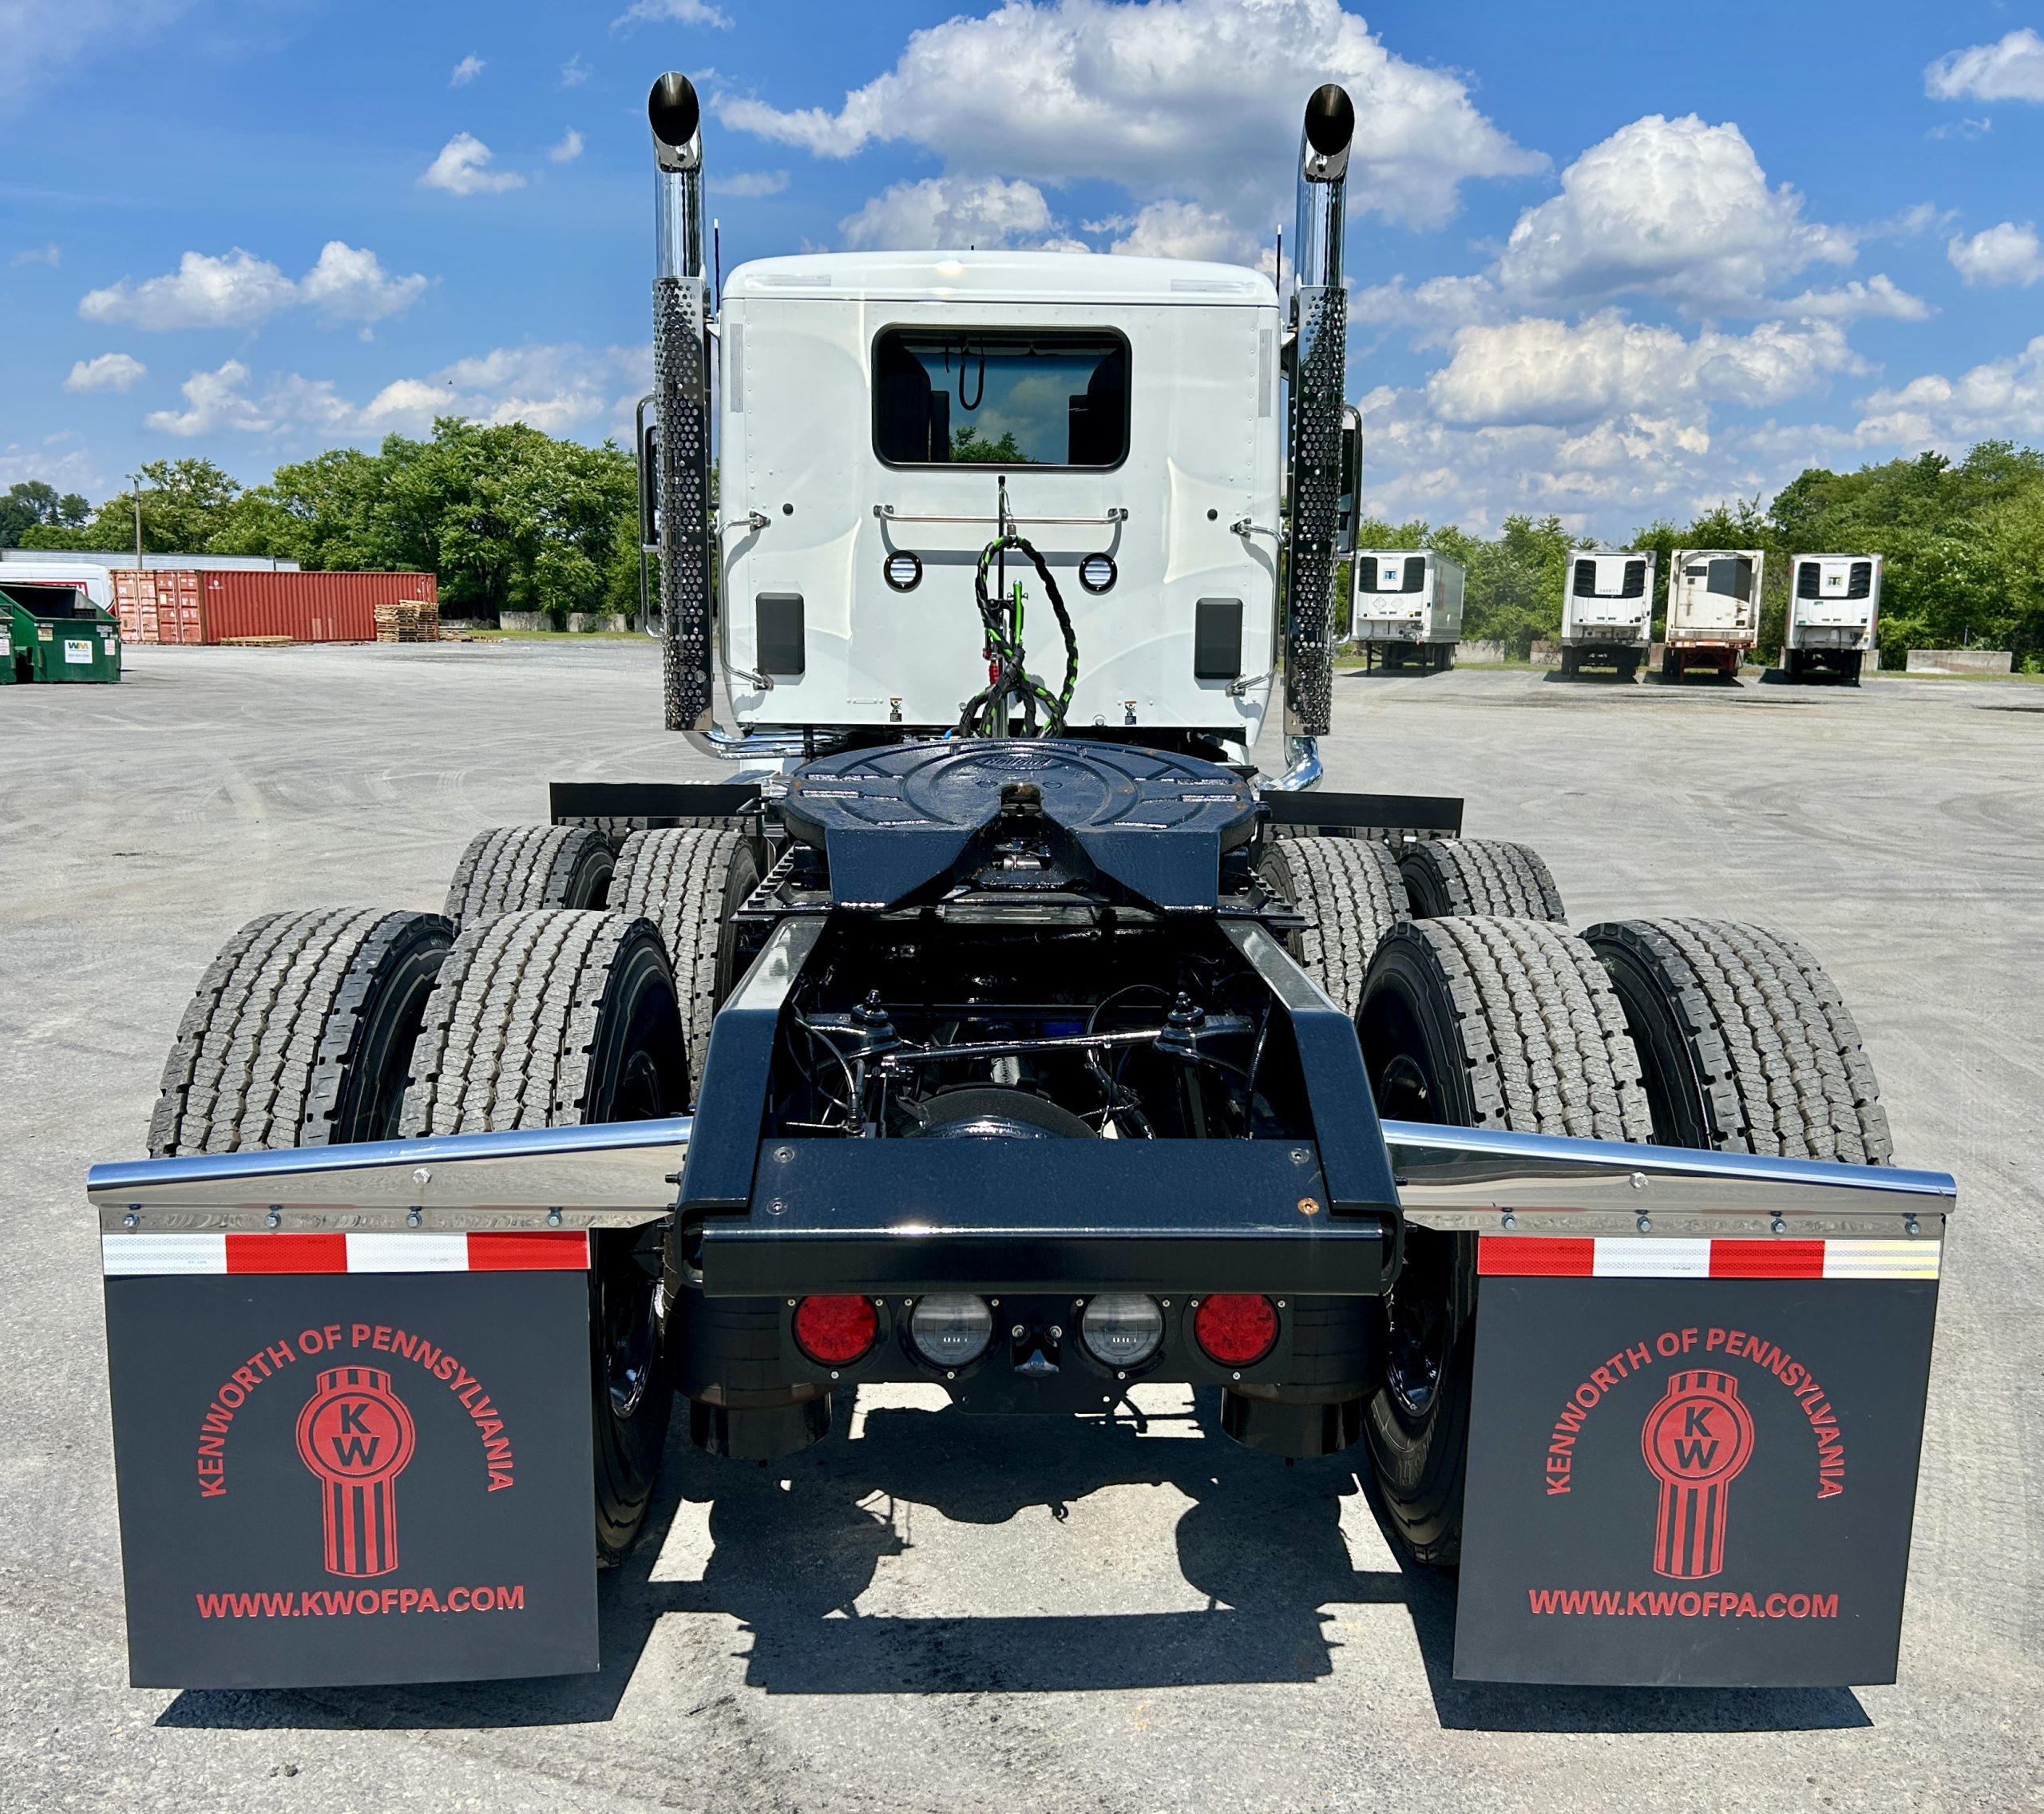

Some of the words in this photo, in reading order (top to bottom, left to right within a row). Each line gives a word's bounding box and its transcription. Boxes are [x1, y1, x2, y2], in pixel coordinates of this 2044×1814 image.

[198, 1341, 295, 1498] KENWORTH
[299, 1325, 342, 1354] OF
[351, 1324, 514, 1492] PENNSYLVANIA
[1546, 1342, 1652, 1495] KENWORTH
[1657, 1328, 1698, 1357] OF
[1706, 1328, 1844, 1499] PENNSYLVANIA
[196, 1585, 525, 1618] WWW.KWOFPA.COM
[1529, 1590, 1839, 1618] WWW.KWOFPA.COM
